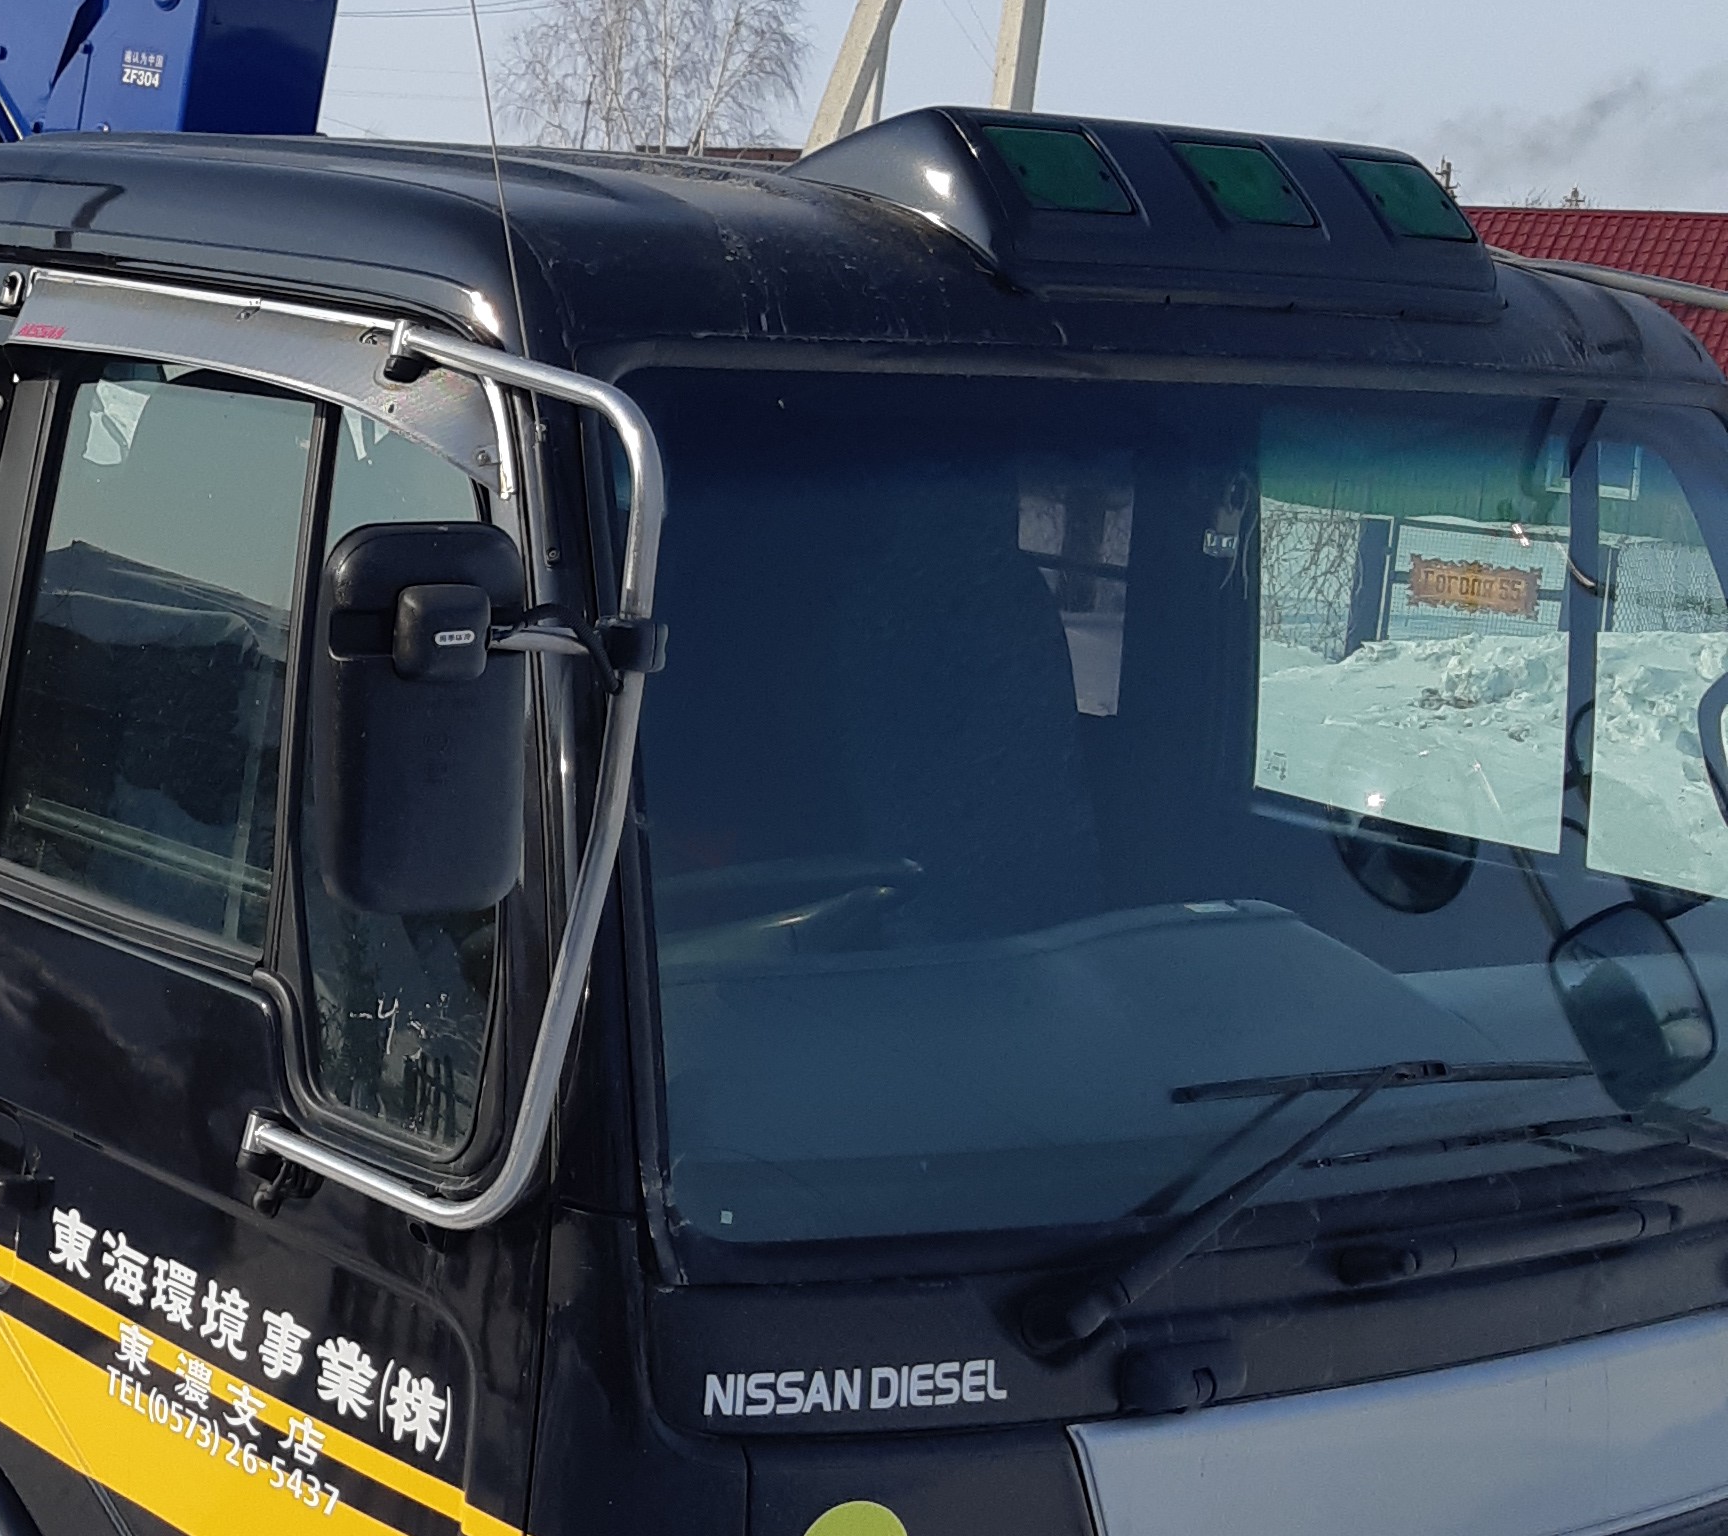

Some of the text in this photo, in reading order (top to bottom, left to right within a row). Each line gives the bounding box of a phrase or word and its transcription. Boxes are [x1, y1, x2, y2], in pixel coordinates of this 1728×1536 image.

[122, 68, 160, 88] ZF304
[1498, 578, 1522, 601] 55
[703, 1359, 1008, 1416] NISSAN DIESEL
